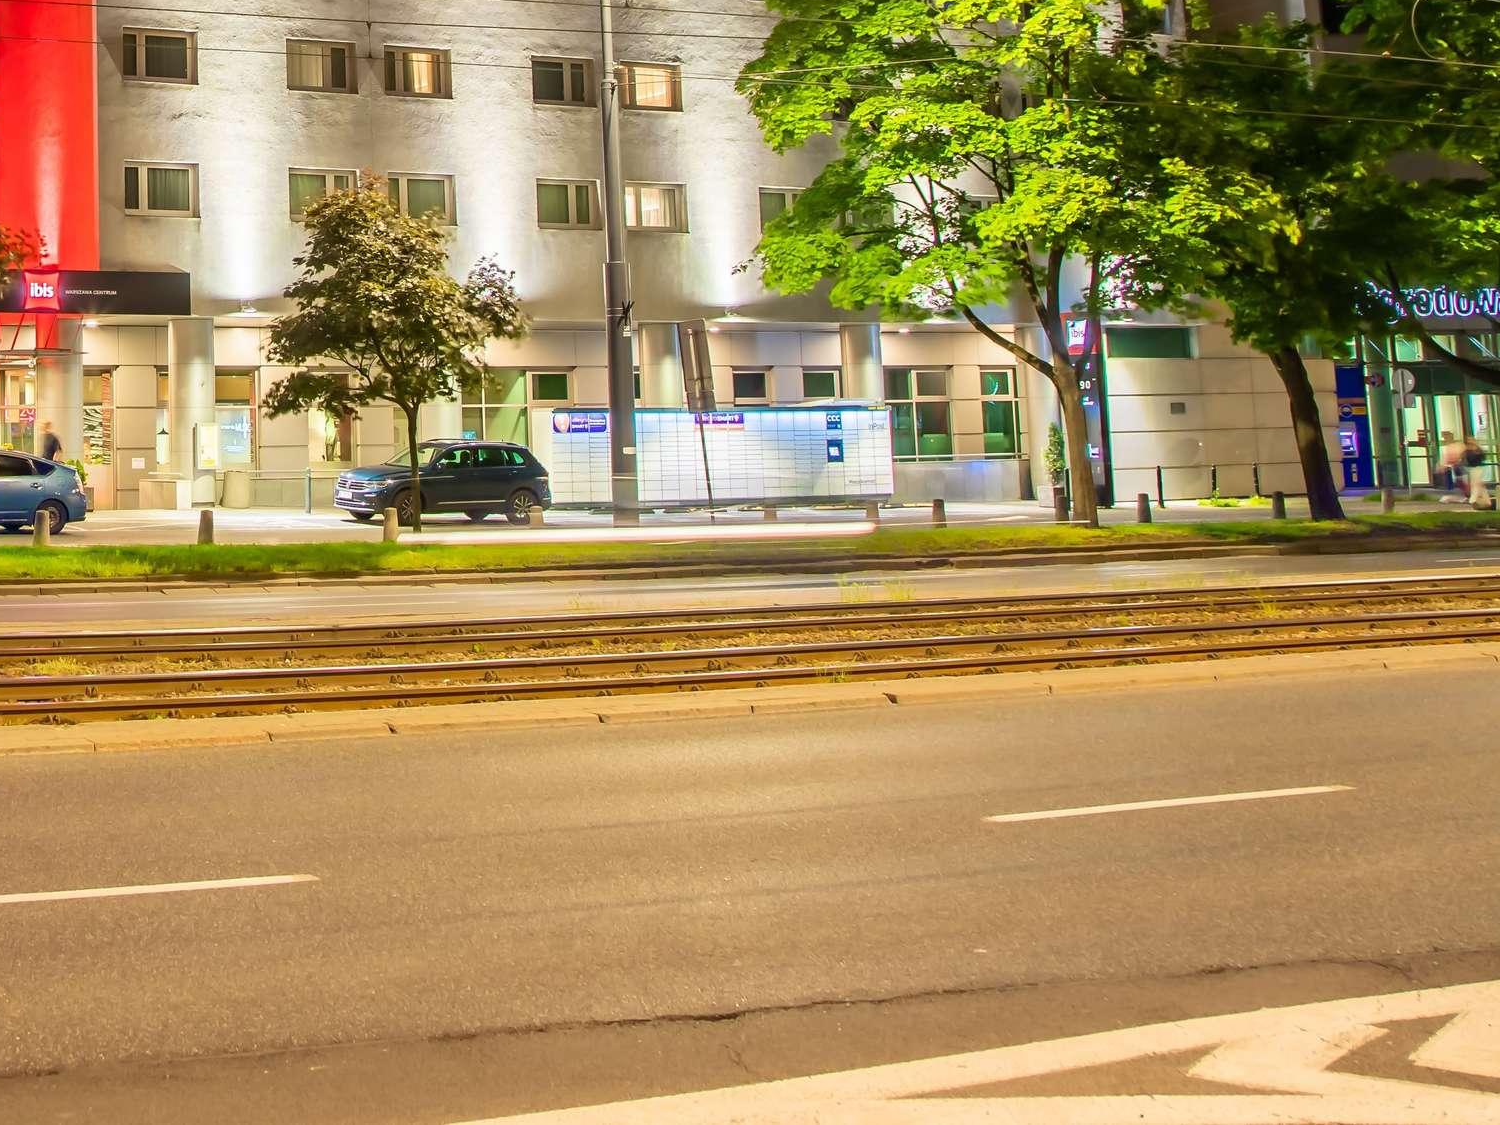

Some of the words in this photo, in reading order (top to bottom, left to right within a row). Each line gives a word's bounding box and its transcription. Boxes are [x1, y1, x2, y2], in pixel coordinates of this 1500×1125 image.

[30, 282, 54, 298] ibis
[1070, 328, 1085, 338] ibis
[826, 414, 841, 422] CCC
